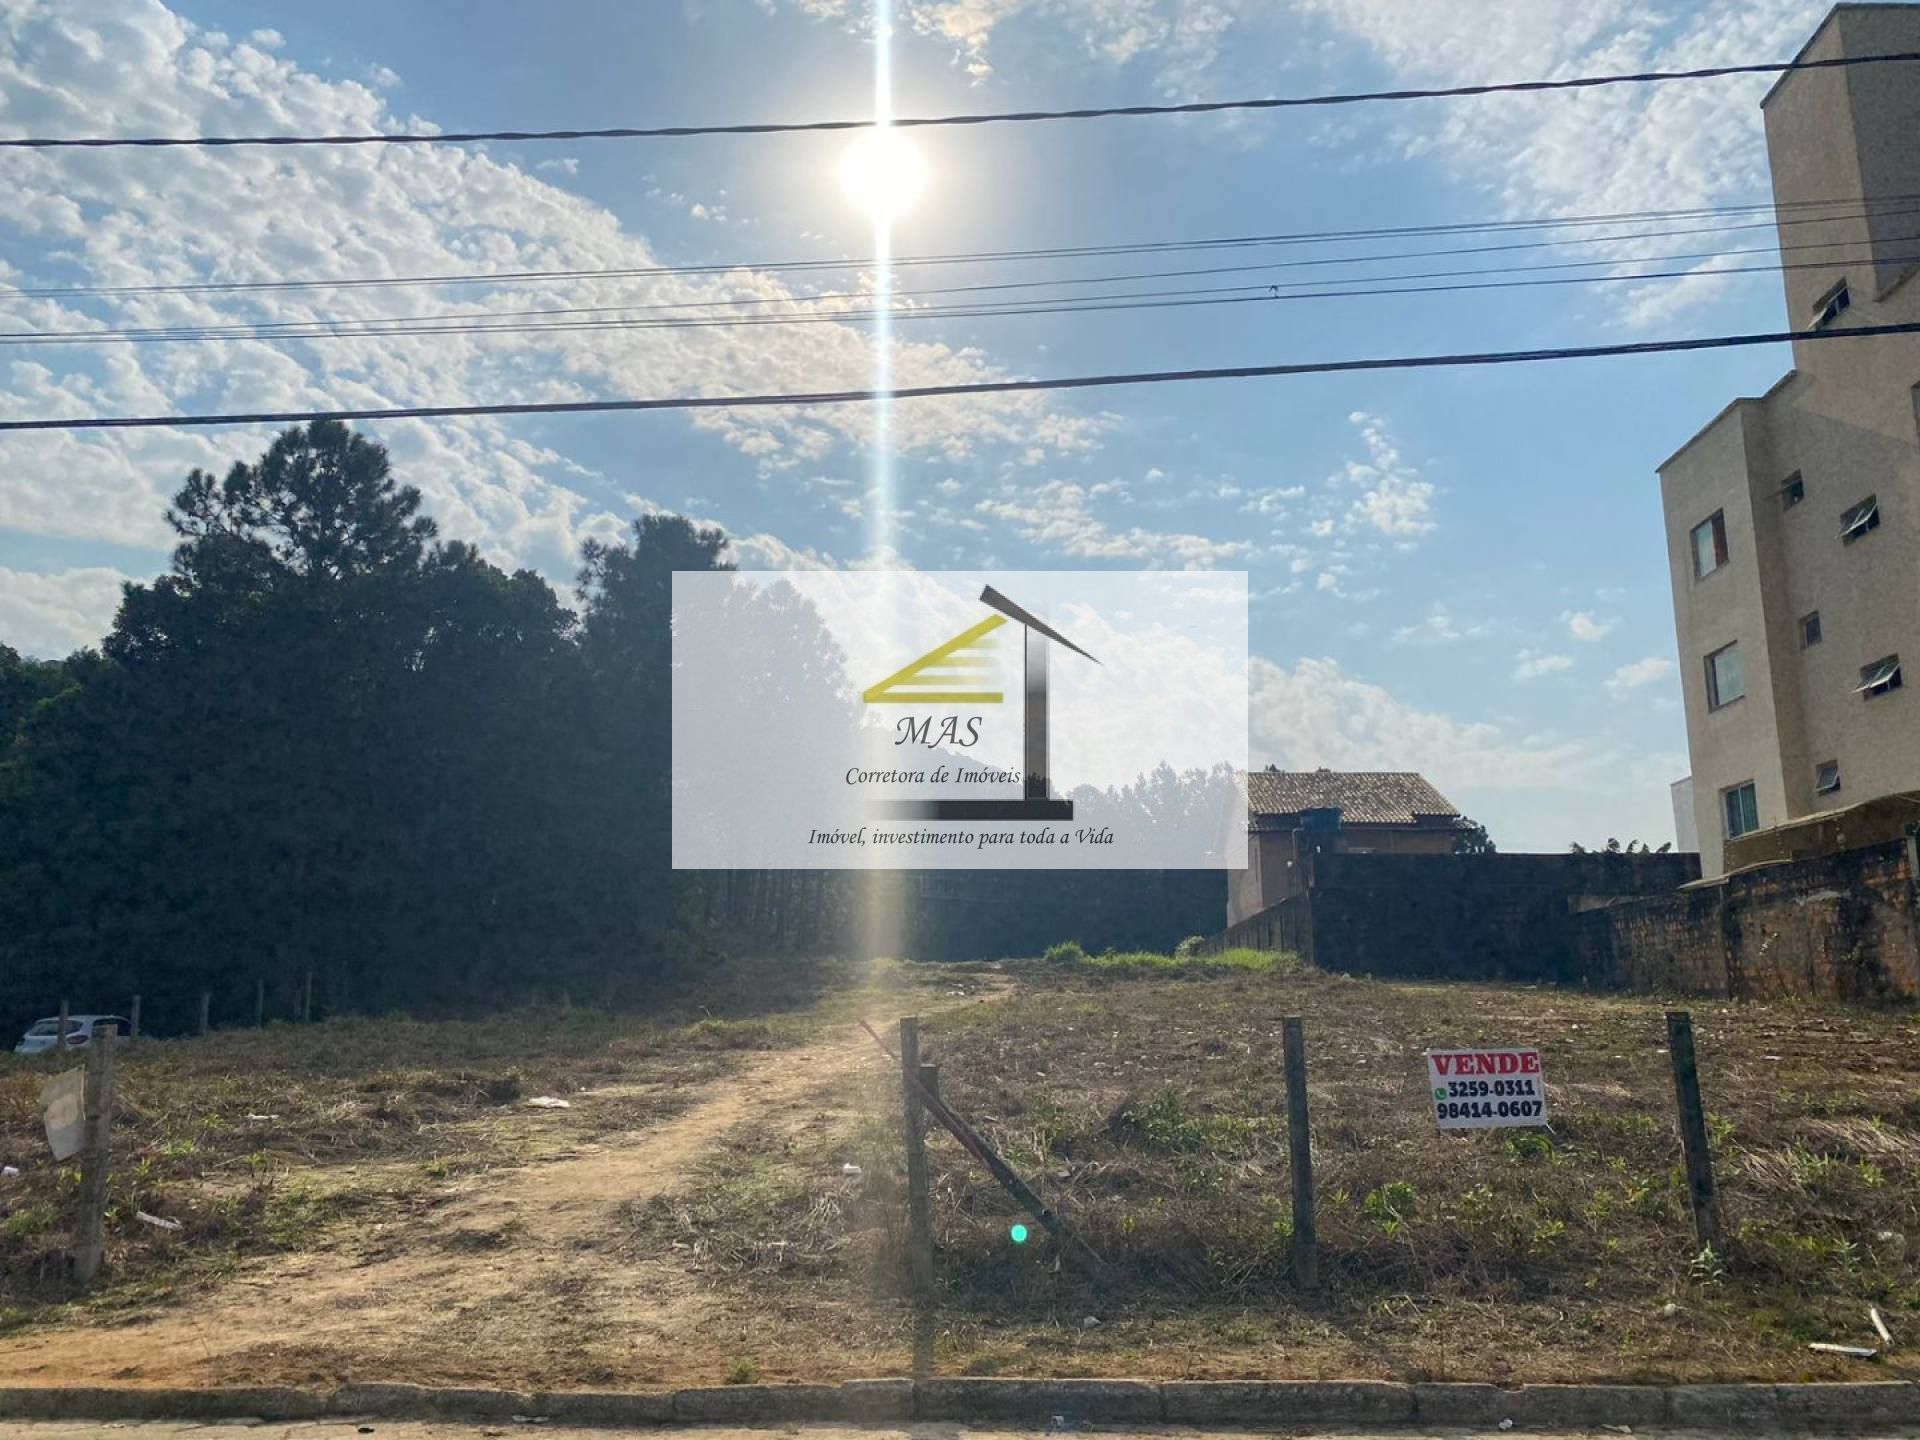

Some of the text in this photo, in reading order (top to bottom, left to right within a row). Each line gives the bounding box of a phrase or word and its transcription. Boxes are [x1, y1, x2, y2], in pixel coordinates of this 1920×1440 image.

[1431, 1052, 1540, 1075] VENDE
[1448, 1079, 1535, 1098] 3259-0311
[1437, 1101, 1543, 1119] 98414-0607
